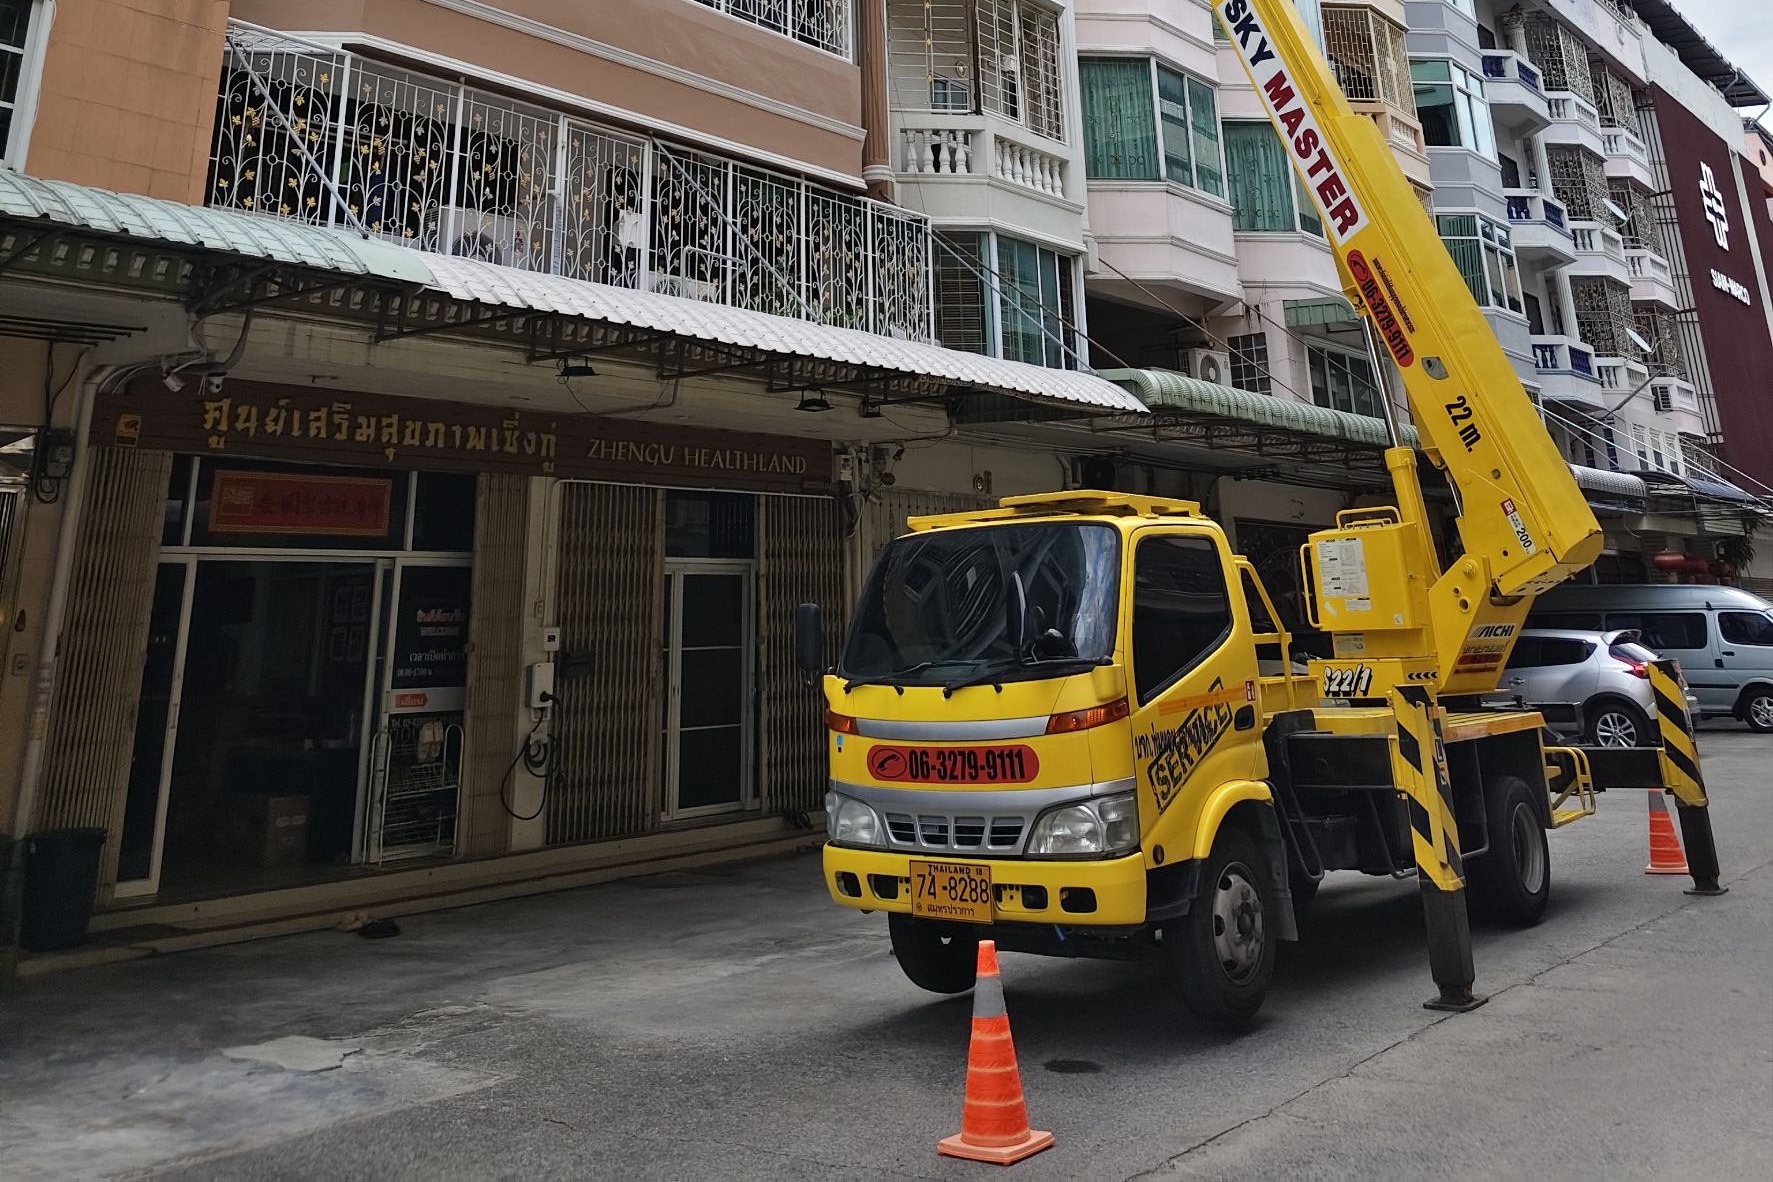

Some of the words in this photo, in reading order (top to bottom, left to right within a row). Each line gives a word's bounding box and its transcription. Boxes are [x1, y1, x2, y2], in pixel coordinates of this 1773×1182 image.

[1263, 70, 1360, 239] MASTER
[1361, 278, 1412, 361] 06-3279-9111
[1445, 395, 1472, 426] 22
[1458, 422, 1481, 453] m.
[587, 439, 674, 467] ZHENGU
[684, 446, 807, 474] HEALTHLAND
[1515, 527, 1533, 548] 200
[1476, 625, 1515, 638] AICHI
[1323, 662, 1373, 697] S22/1
[908, 748, 1026, 781] 06-3279-9111
[1156, 702, 1229, 800] SERVICE
[928, 864, 971, 875] THAILAND
[927, 903, 975, 917] สมุทรปราการ
